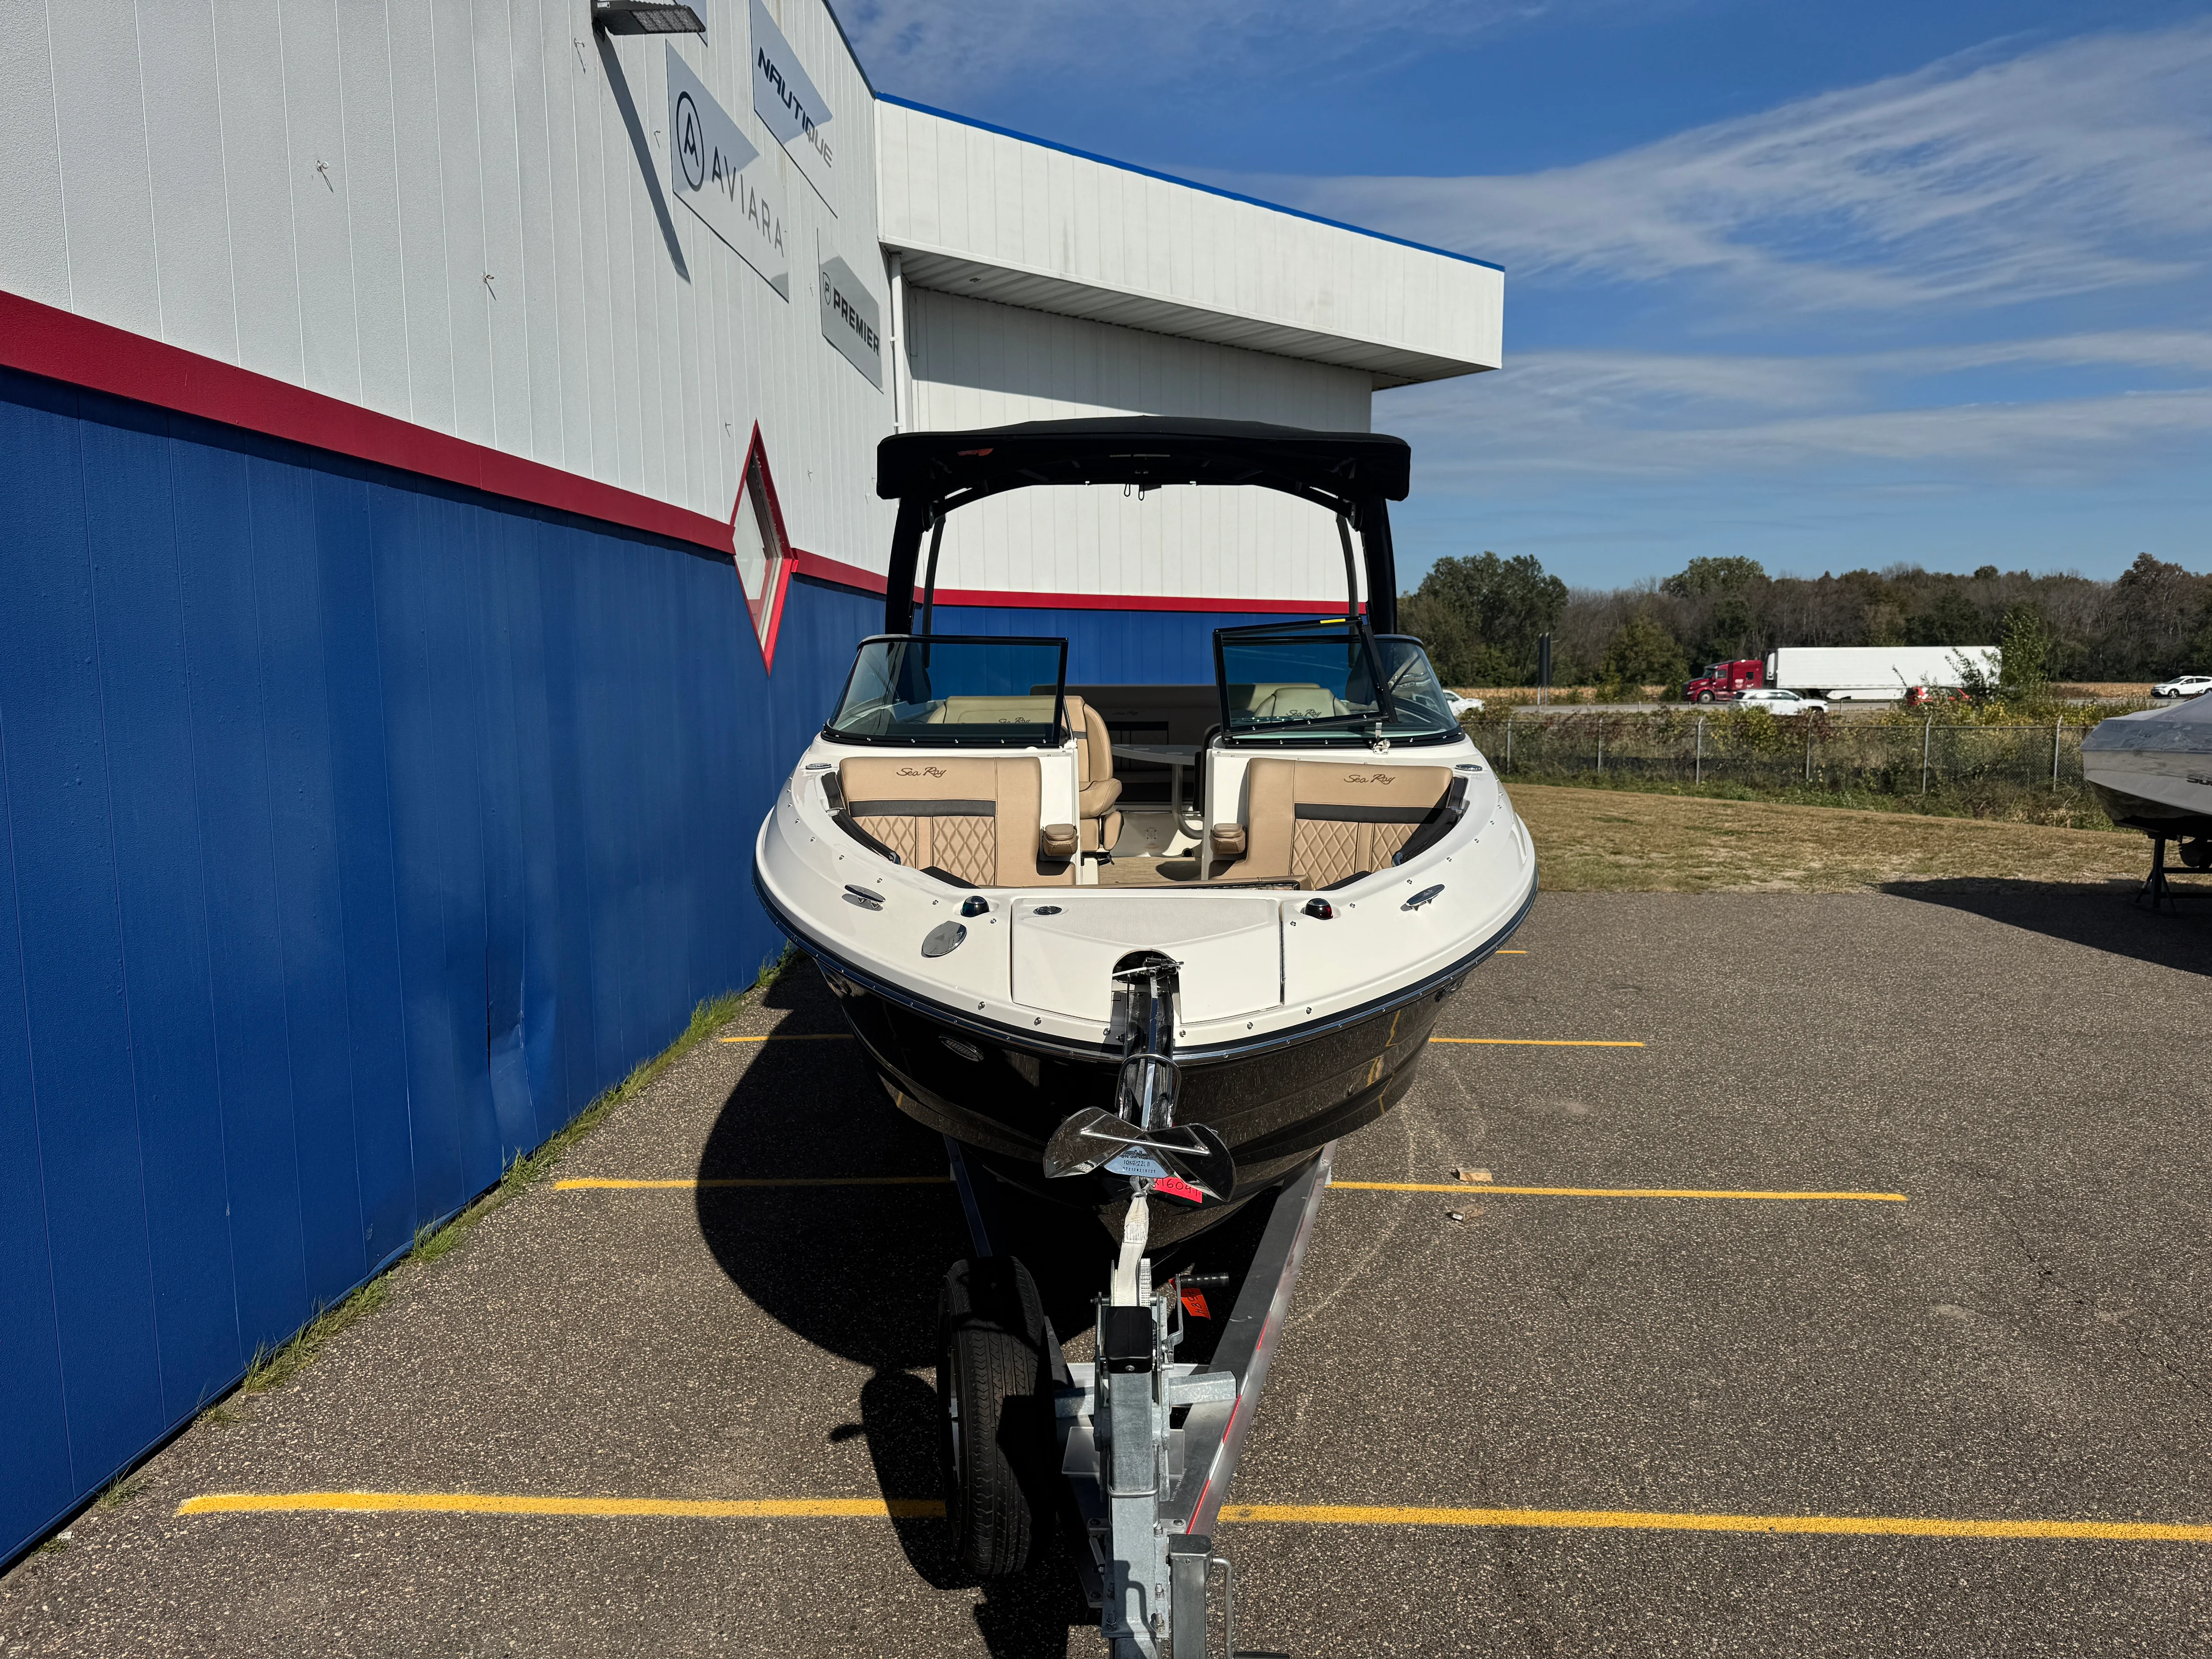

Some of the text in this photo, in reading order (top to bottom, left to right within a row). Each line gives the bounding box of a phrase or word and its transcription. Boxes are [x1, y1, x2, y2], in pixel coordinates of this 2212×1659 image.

[758, 46, 833, 168] NAUTIQUE
[711, 146, 784, 257] AVIARA
[833, 286, 879, 357] PREMIER
[1305, 709, 1322, 718] Ray
[896, 766, 947, 778] Sea Ray
[1371, 774, 1396, 785] Ray
